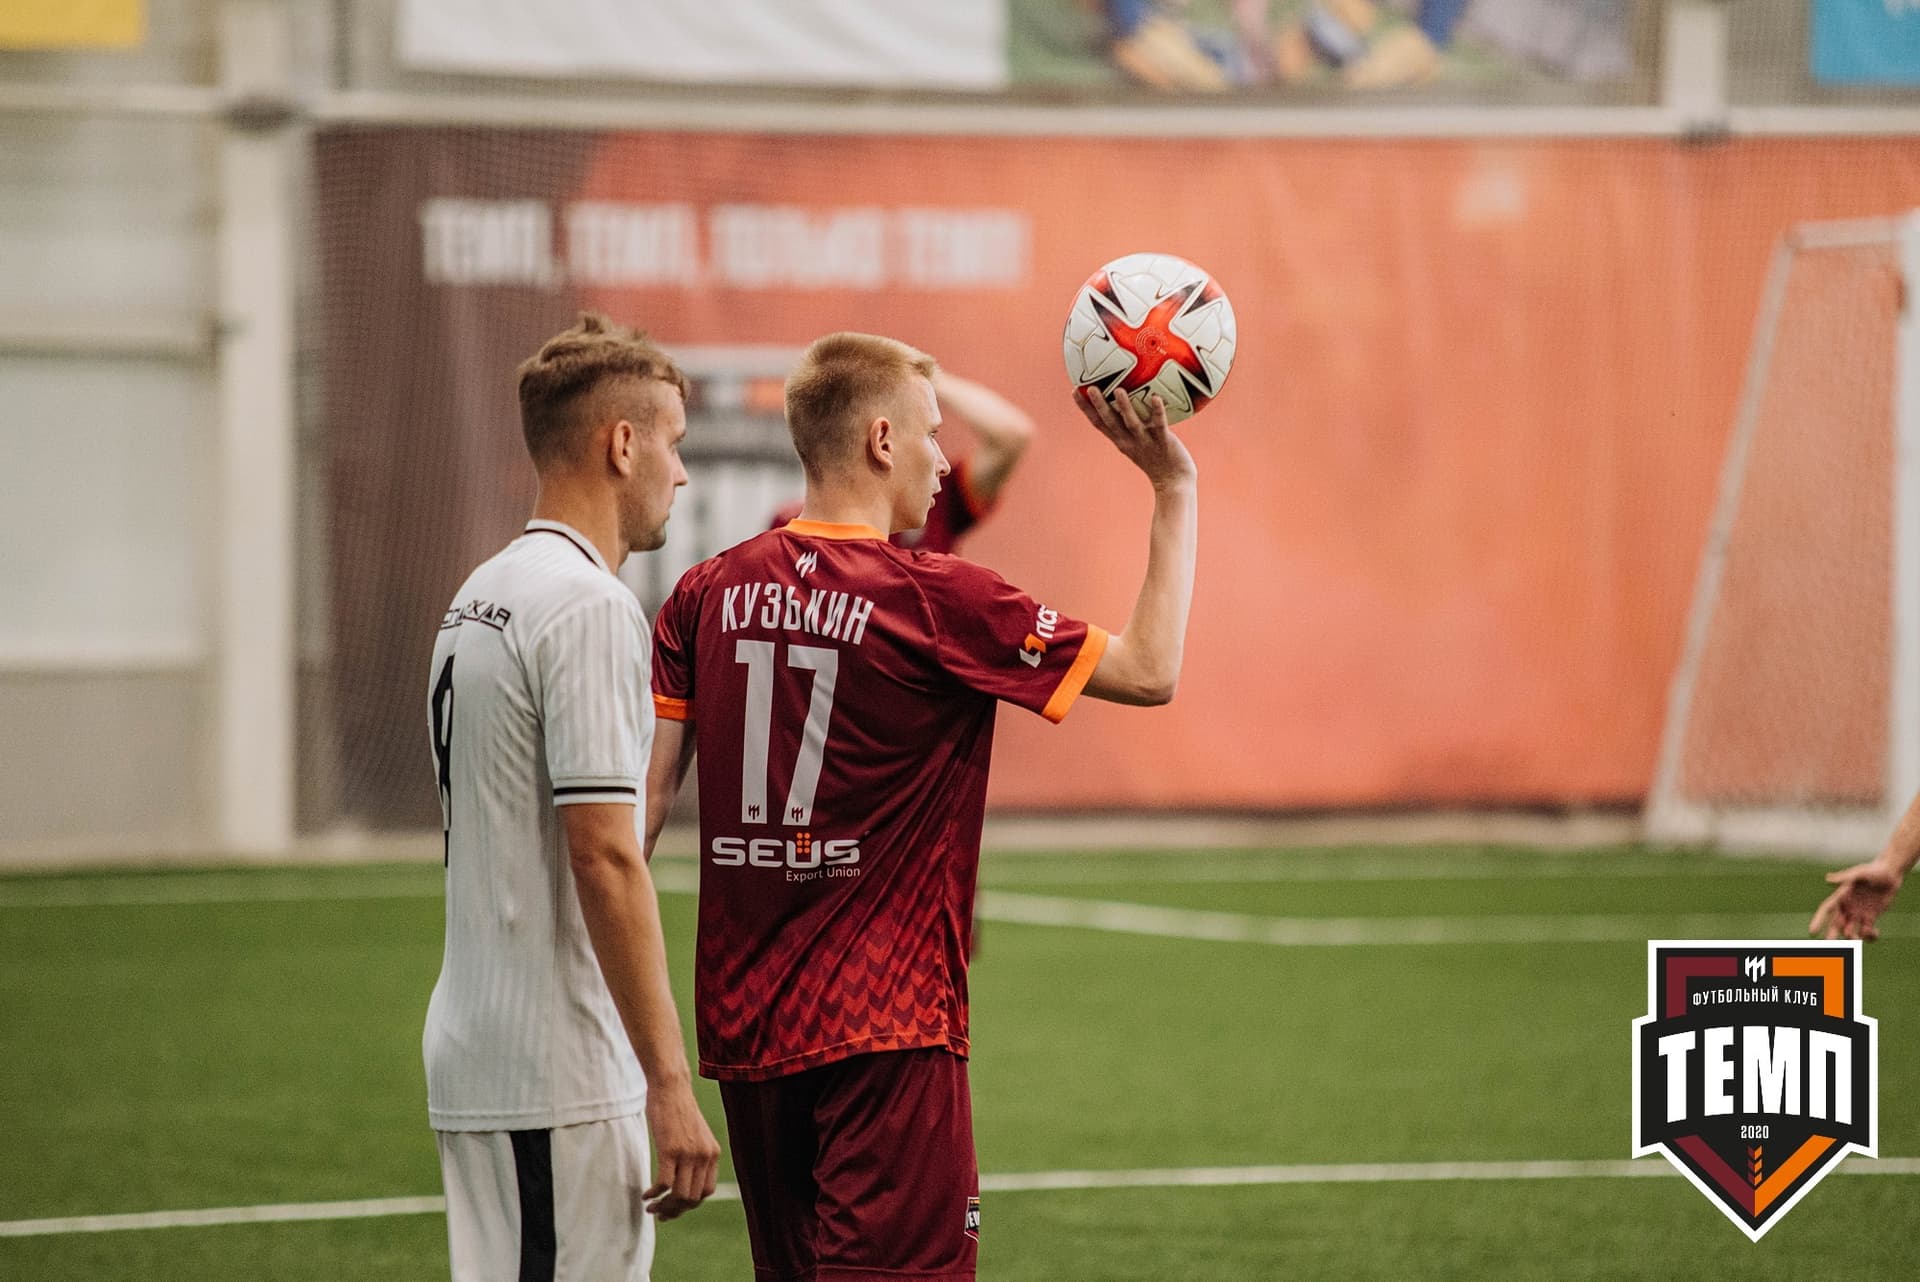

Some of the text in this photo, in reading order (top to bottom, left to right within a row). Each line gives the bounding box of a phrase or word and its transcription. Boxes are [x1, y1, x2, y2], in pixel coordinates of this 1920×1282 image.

[721, 582, 875, 645] КУЗЬКИН
[735, 639, 839, 826] 17
[785, 866, 861, 883] Export Union
